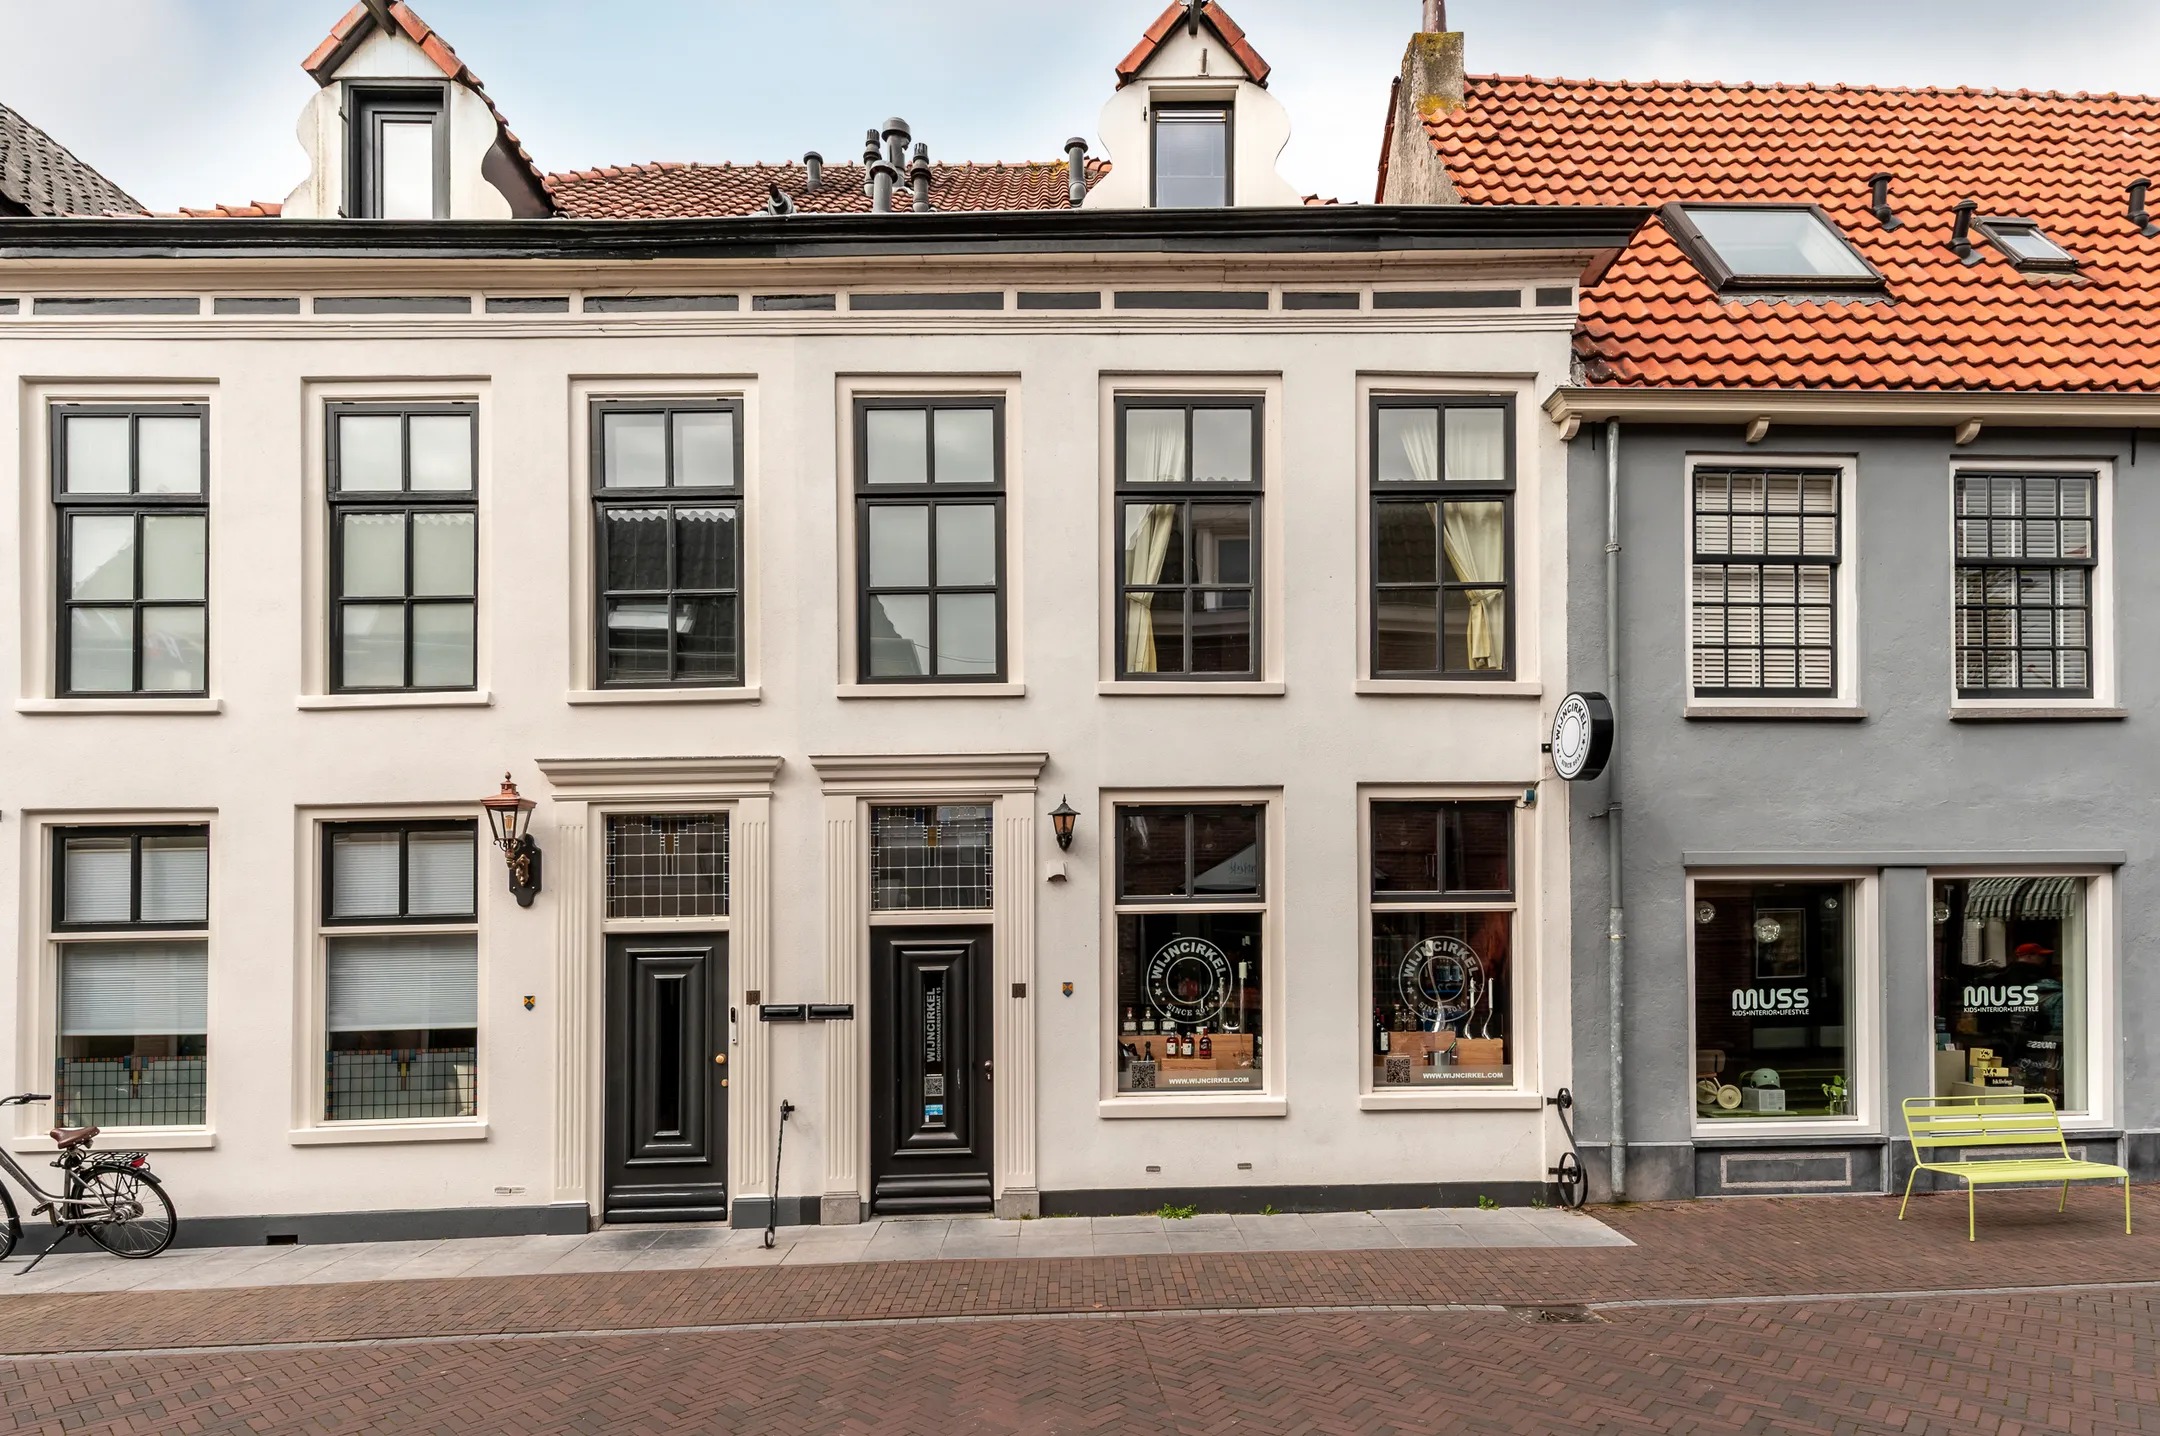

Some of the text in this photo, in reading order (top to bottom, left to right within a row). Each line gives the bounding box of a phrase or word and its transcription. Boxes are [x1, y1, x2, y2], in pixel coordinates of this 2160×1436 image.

[1555, 703, 1587, 740] WIJNCIRKEL
[1151, 941, 1227, 979] WIJNCIRKEL
[1403, 940, 1479, 978] WIJNCIRKEL
[1166, 1002, 1193, 1016] SINCE
[1417, 1001, 1443, 1015] SINC
[1732, 988, 1809, 1009] MUSS
[1964, 985, 2039, 1006] MUSS
[926, 987, 936, 1063] WIJNCIRKEL
